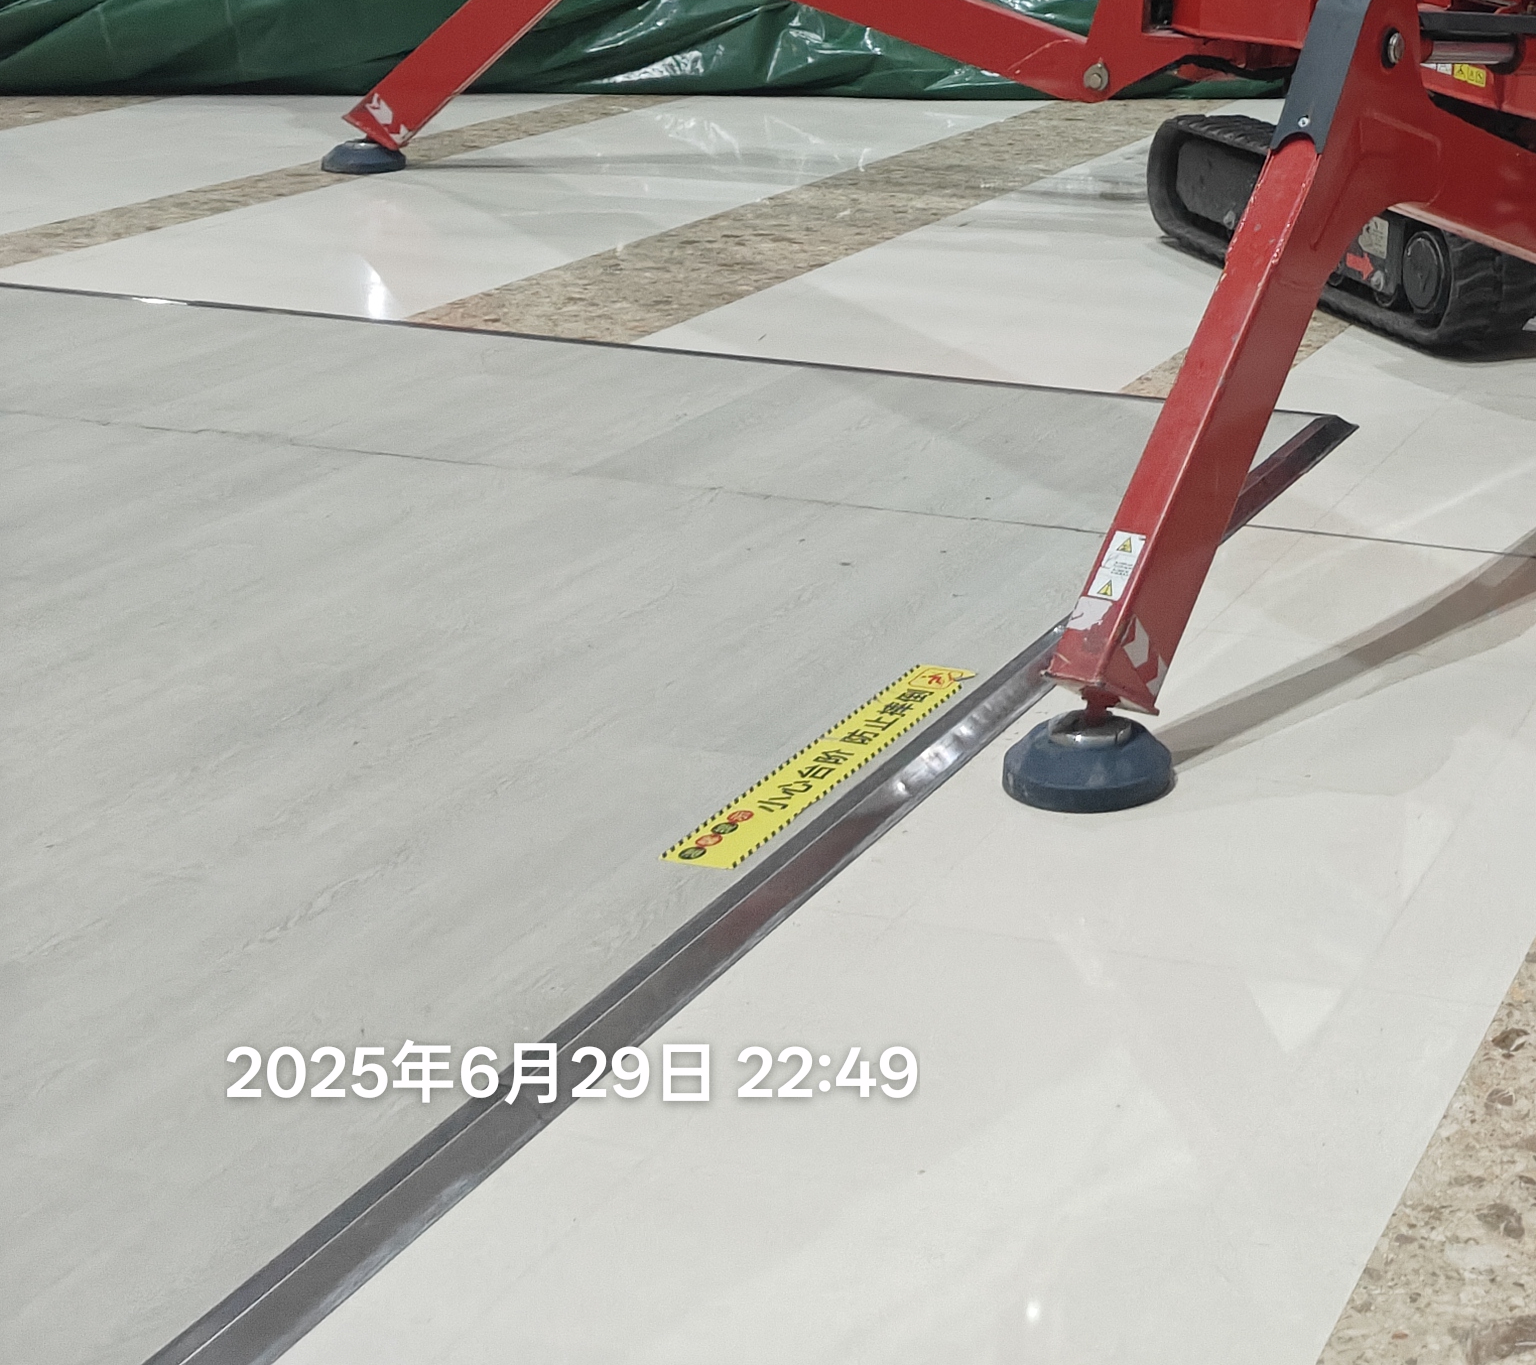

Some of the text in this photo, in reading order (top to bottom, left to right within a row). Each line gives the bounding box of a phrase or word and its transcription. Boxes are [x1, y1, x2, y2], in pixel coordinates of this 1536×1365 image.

[757, 687, 935, 813] 小心台阶 防止摔倒
